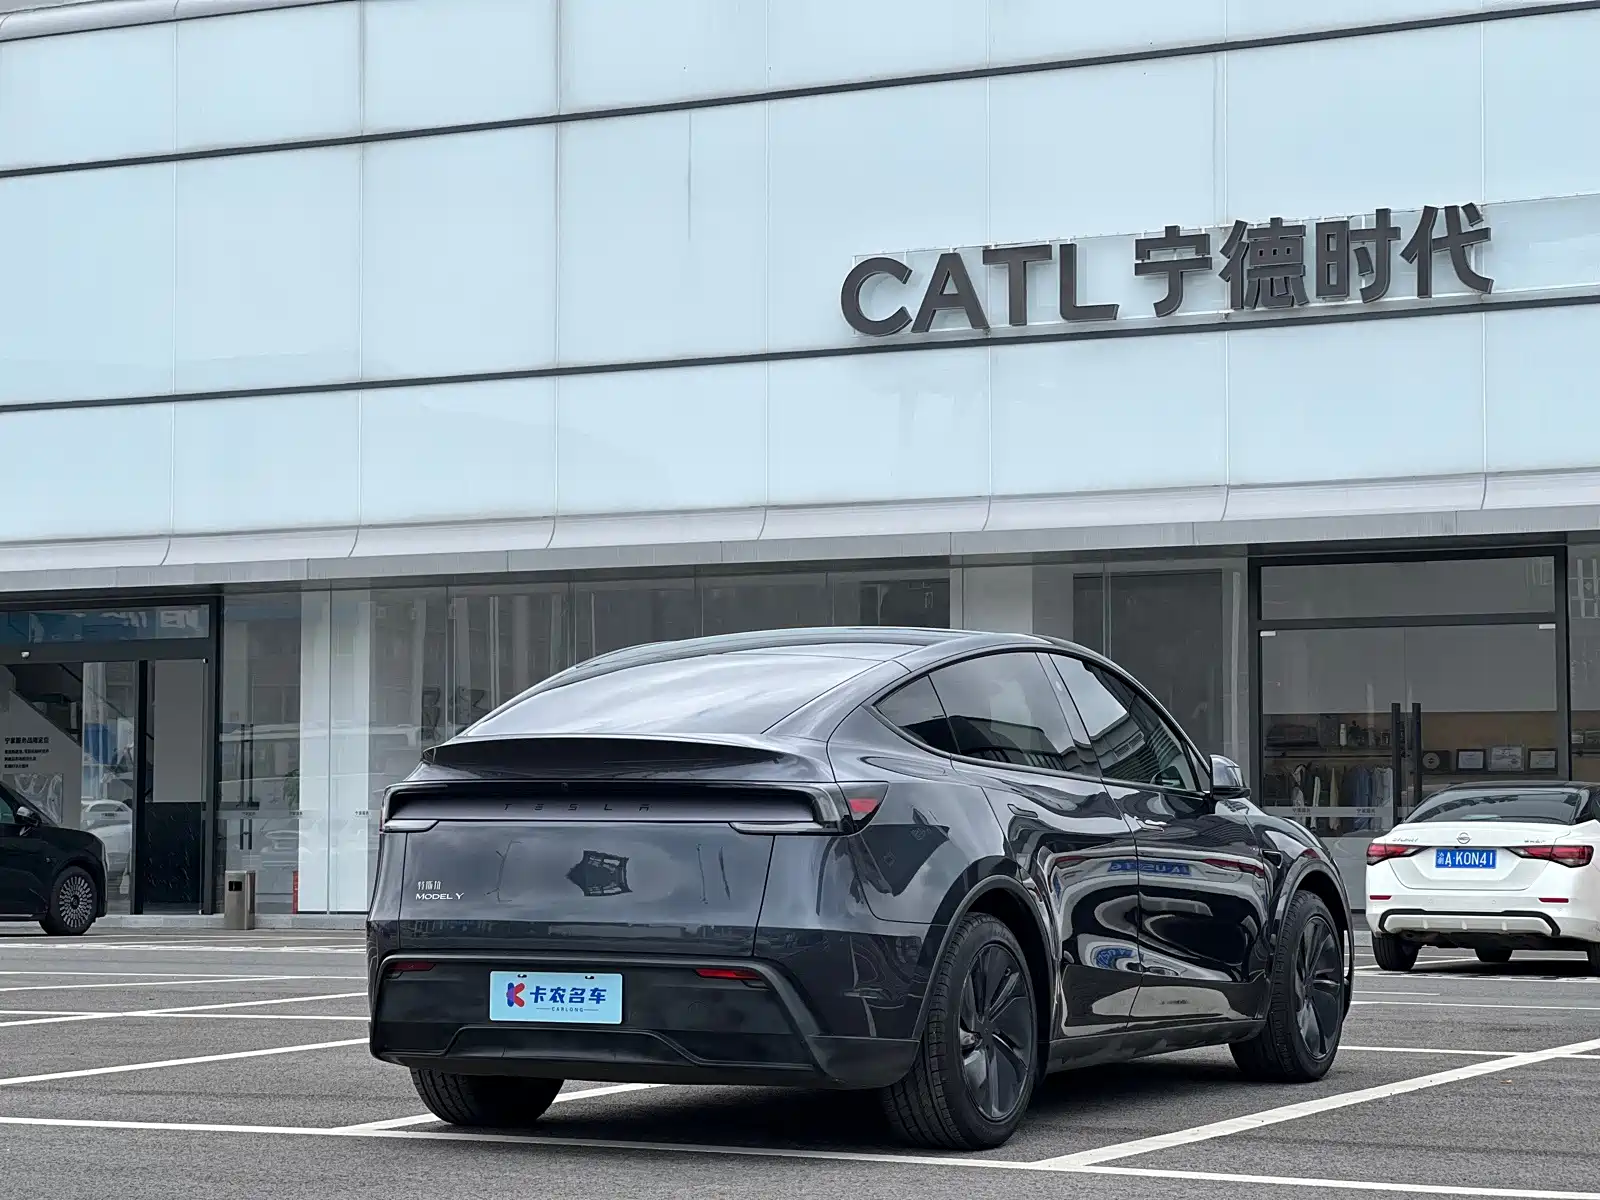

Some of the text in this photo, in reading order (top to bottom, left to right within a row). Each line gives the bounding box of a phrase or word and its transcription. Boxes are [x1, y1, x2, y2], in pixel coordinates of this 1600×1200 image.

[840, 202, 1492, 337] CATL 宁德时代
[504, 803, 650, 812] TESLA
[455, 892, 464, 900] Y
[530, 985, 607, 1005] 卡农名车
